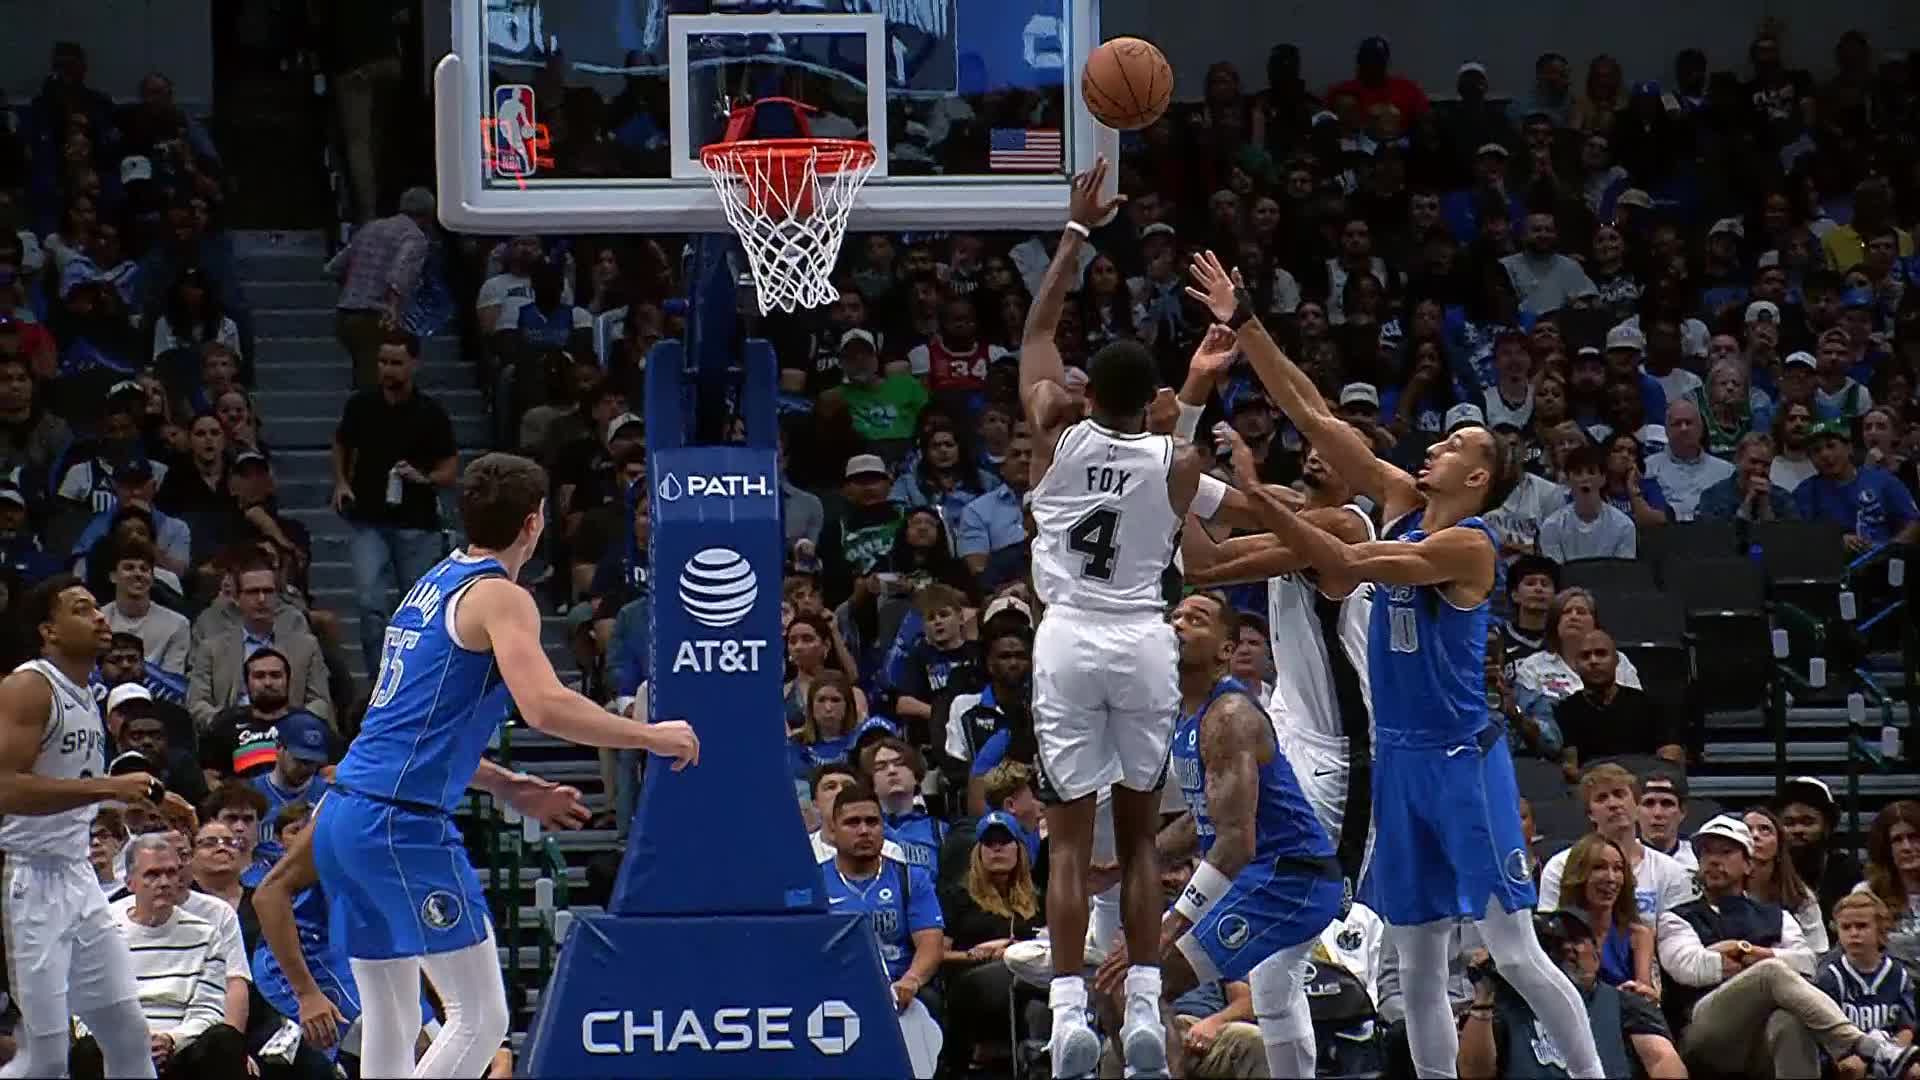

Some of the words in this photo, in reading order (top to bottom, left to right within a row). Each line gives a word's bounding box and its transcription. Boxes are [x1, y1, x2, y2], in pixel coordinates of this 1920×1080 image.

[1087, 466, 1132, 496] FOX
[1066, 503, 1122, 583] 4
[672, 640, 767, 673] AT&T
[1184, 884, 1209, 908] 25
[582, 1007, 795, 1054] CHASE
